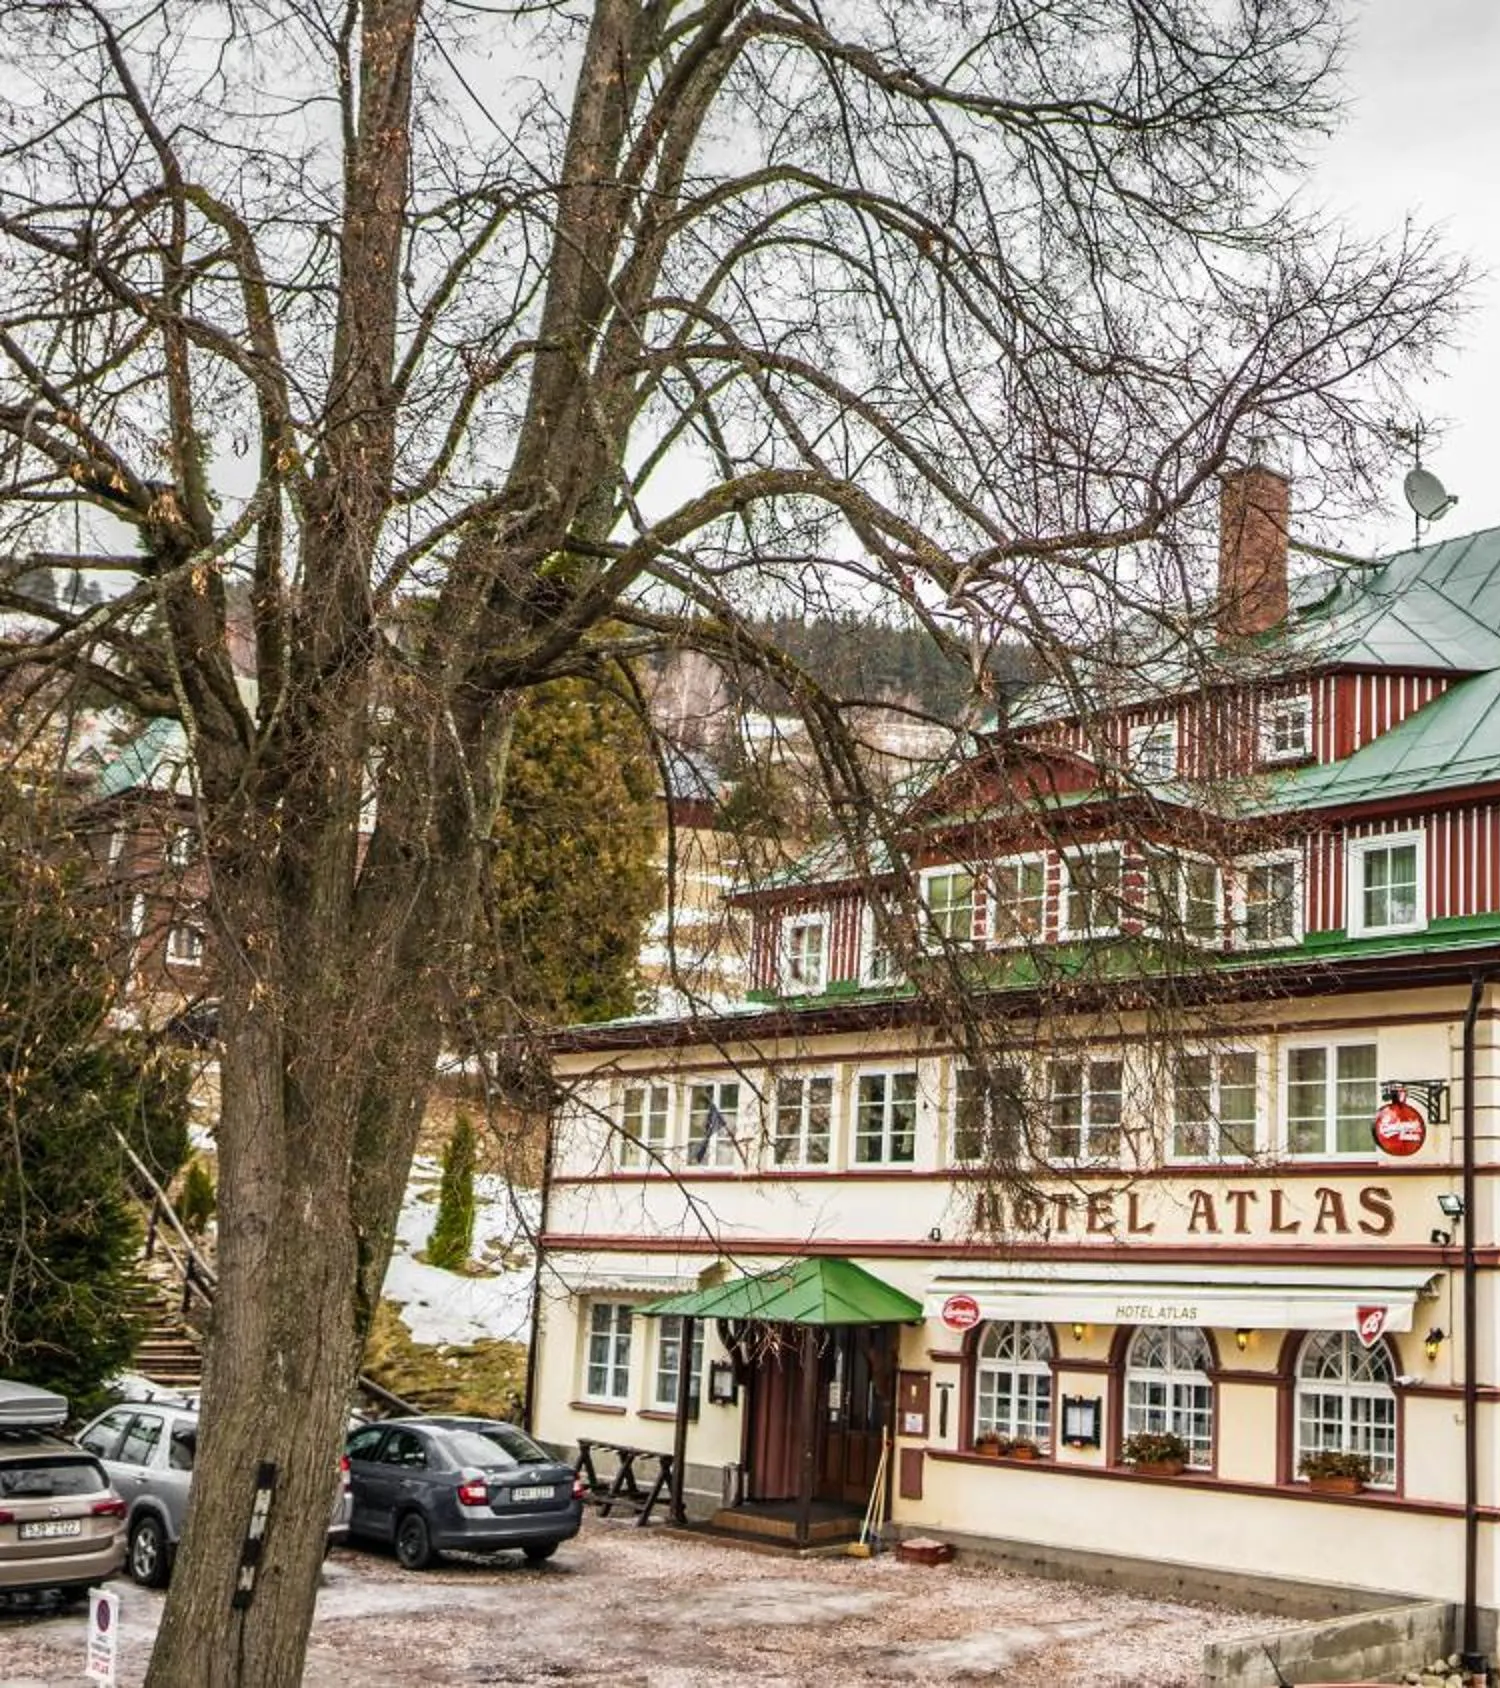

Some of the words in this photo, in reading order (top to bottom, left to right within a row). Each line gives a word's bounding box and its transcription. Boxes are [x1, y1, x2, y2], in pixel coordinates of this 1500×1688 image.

[974, 1191, 1156, 1235] HOTEL
[1187, 1186, 1396, 1237] ATLAS
[1115, 1304, 1155, 1319] HOTEL
[1158, 1306, 1198, 1320] ATLAS
